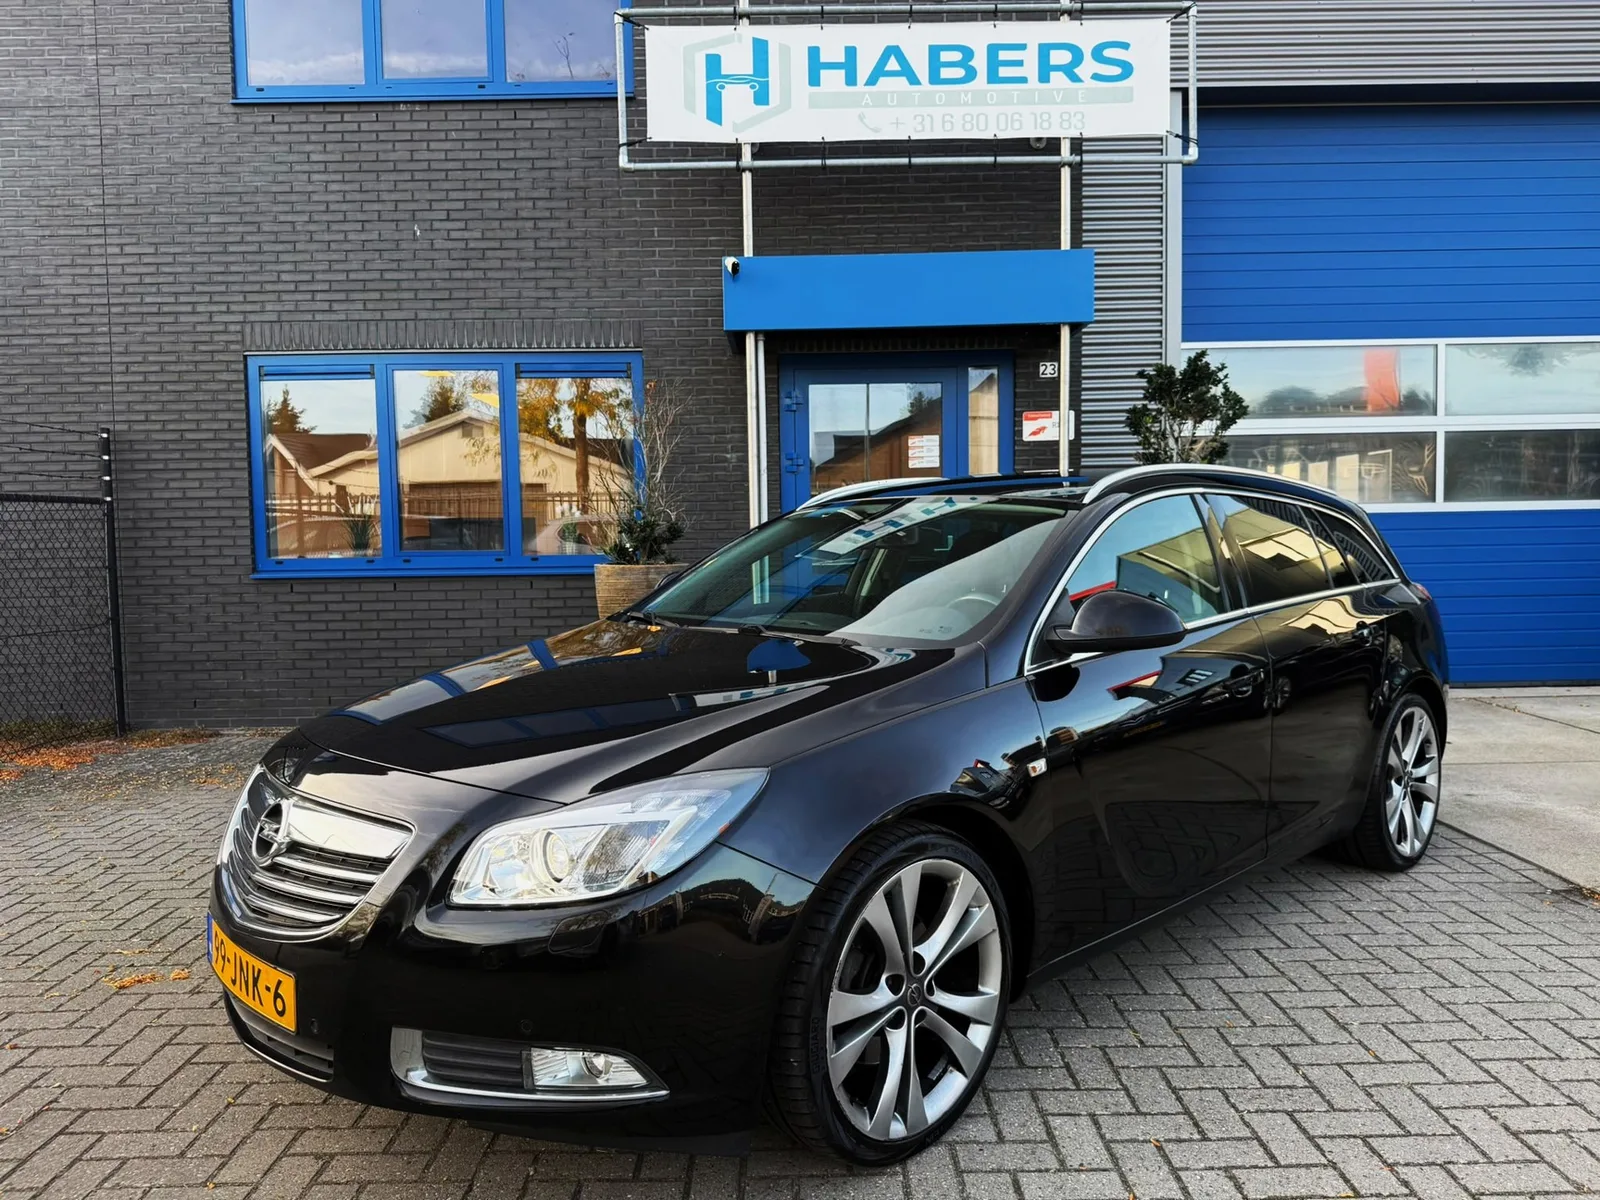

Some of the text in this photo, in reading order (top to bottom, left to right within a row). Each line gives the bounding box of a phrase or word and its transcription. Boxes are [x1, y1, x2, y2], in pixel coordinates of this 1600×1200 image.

[807, 41, 1134, 88] HABERS
[862, 90, 1086, 106] AUTOMOTIVE
[913, 113, 934, 133] 31
[942, 113, 955, 132] 6
[961, 112, 989, 132] 80
[996, 112, 1023, 131] 06
[1030, 111, 1052, 131] 18
[1059, 111, 1085, 130] 83
[1040, 363, 1057, 376] 23
[214, 930, 287, 1018] 99-JNK-6
